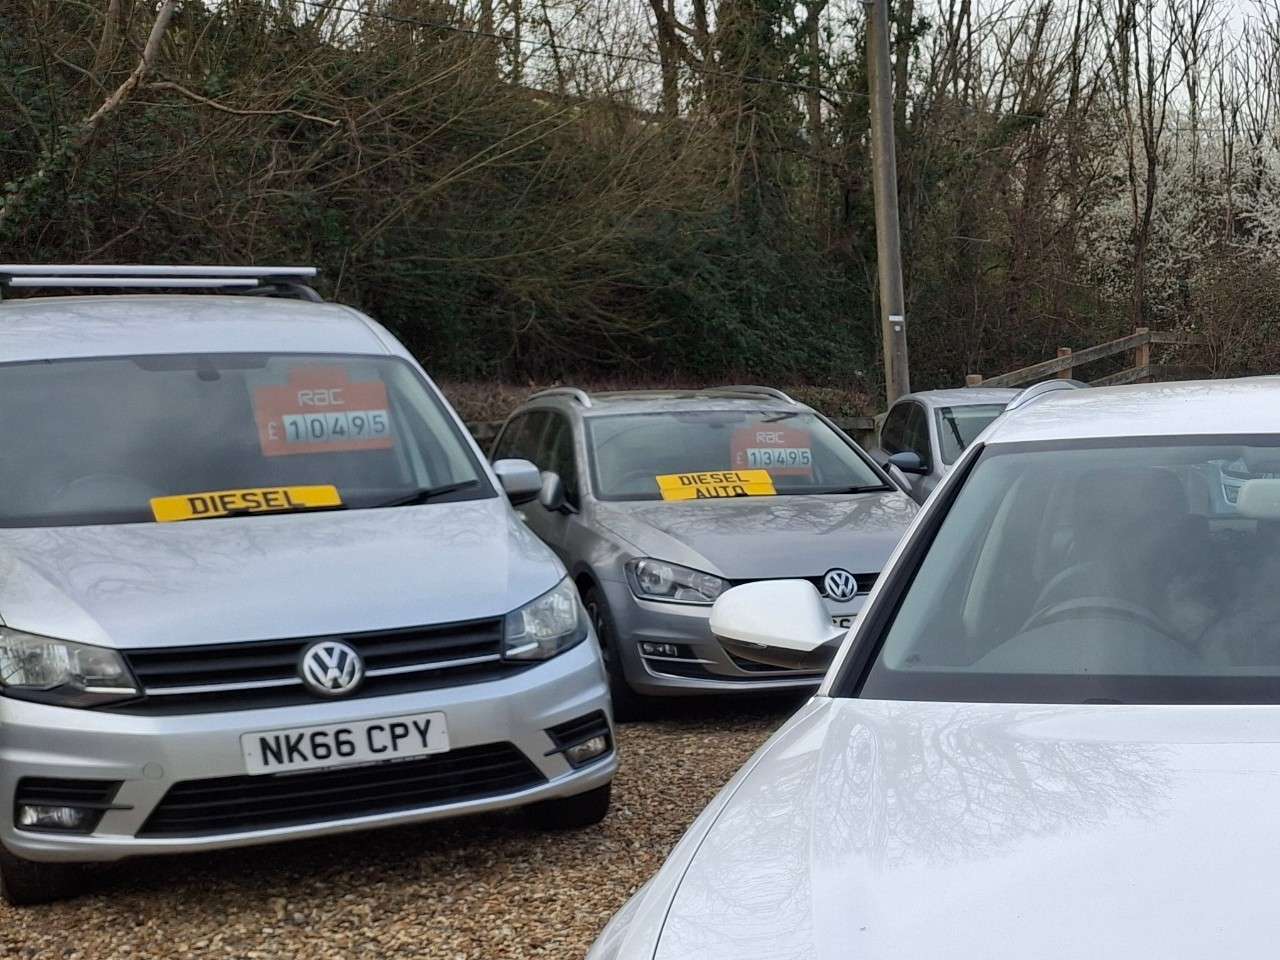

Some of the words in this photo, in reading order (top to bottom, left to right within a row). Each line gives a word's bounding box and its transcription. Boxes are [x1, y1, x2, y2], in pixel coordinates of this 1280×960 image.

[678, 472, 749, 486] DIESEL
[695, 485, 745, 499] AUTO
[187, 490, 305, 515] DIESEL
[259, 729, 355, 766] NK66
[366, 719, 431, 753] CPY
